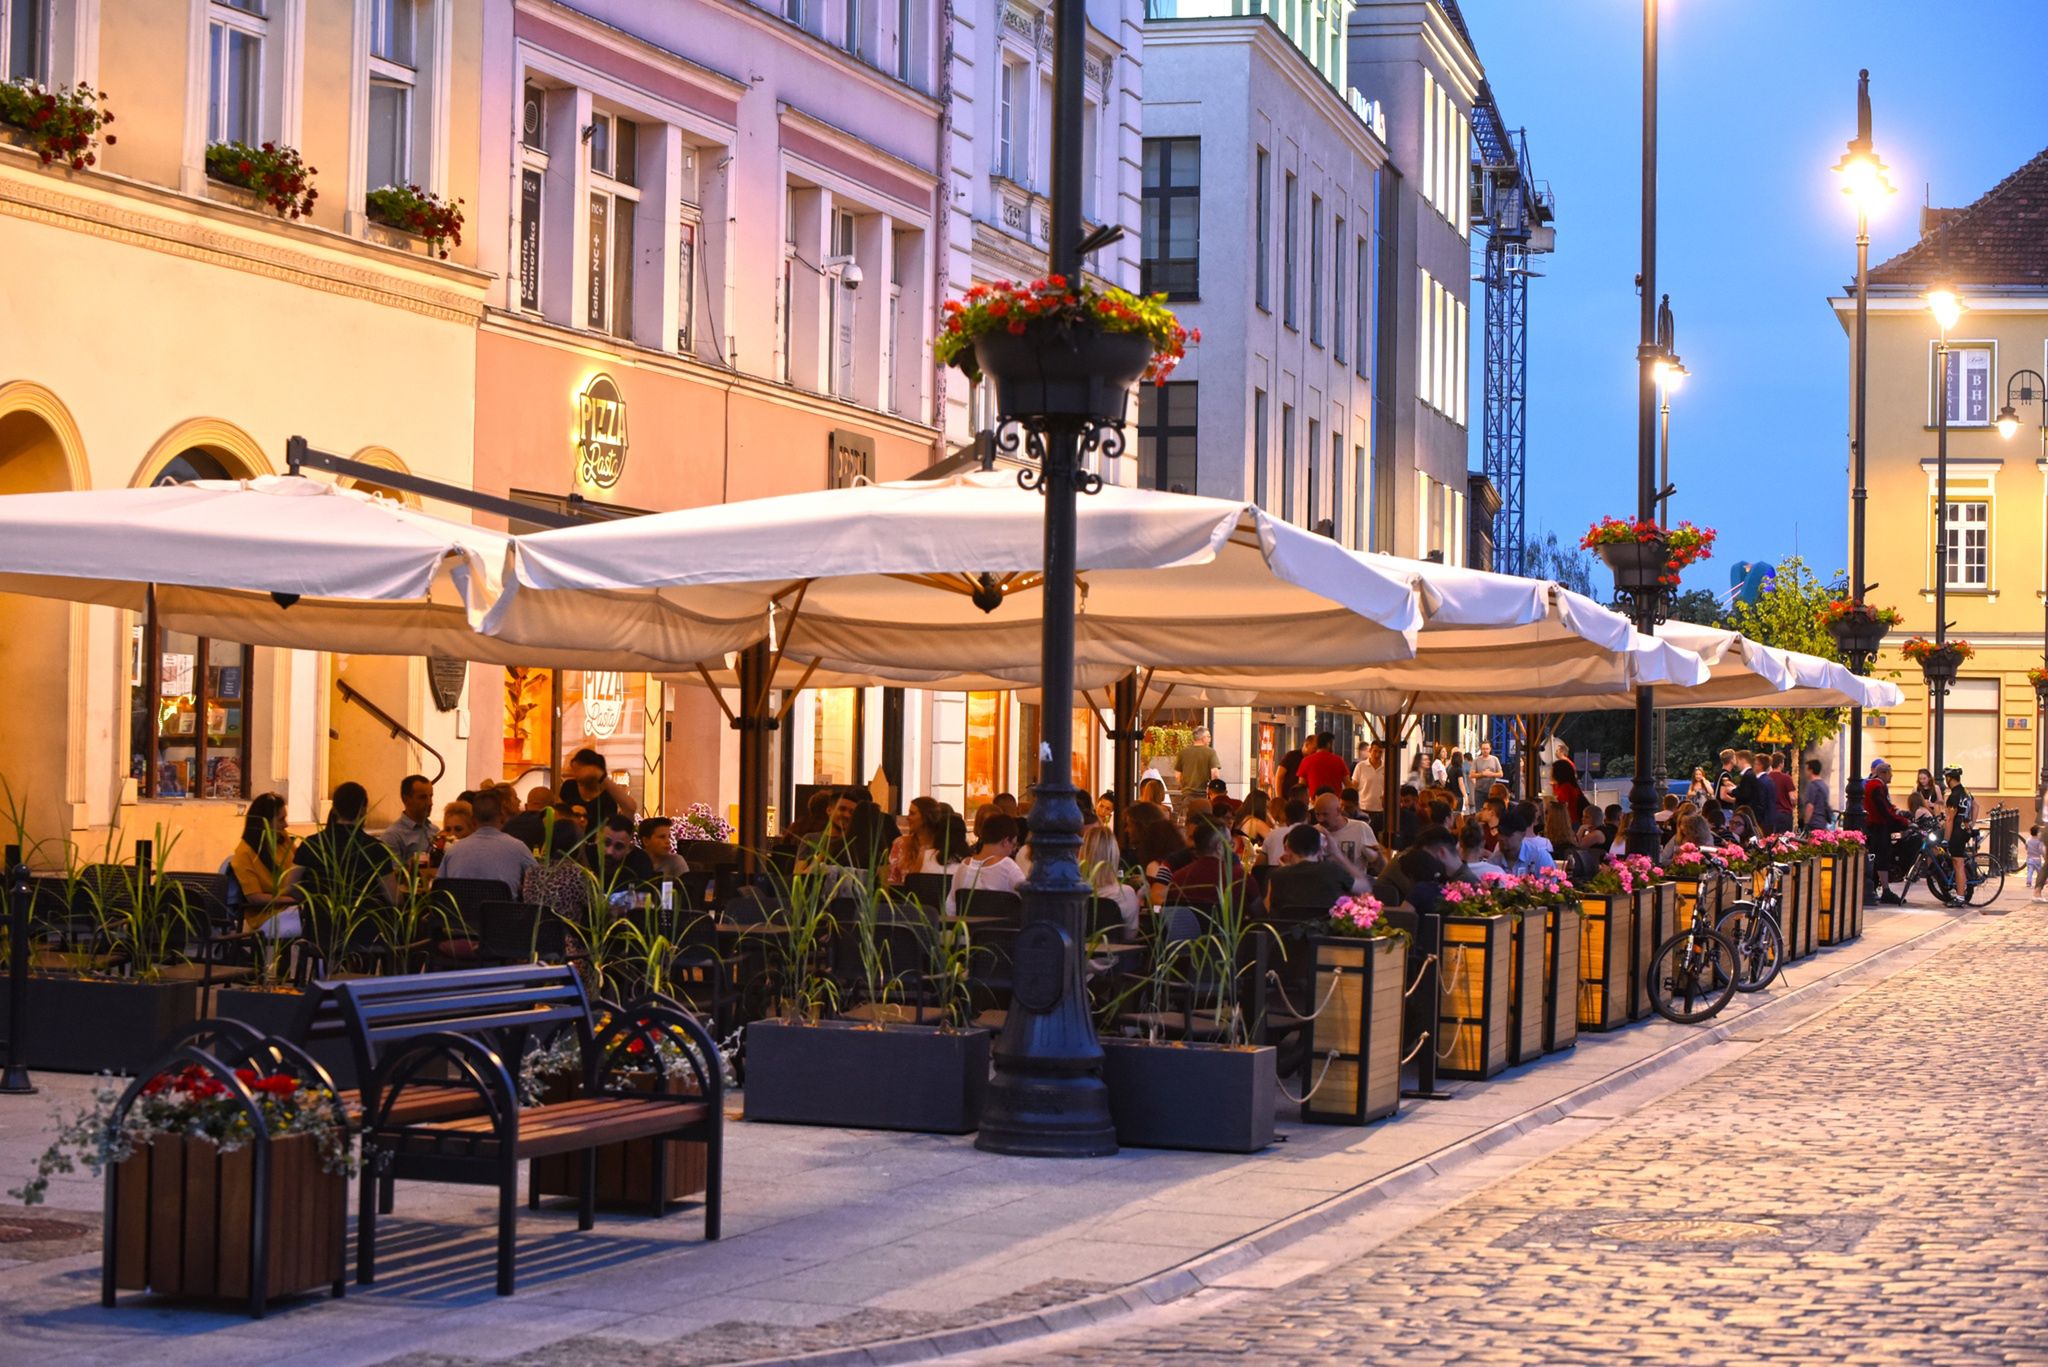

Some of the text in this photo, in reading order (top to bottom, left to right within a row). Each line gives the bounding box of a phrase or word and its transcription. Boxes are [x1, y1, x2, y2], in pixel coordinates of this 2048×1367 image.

[520, 240, 529, 299] Galeria
[527, 221, 536, 301] Pomorska
[592, 234, 600, 320] Salon NC+
[1972, 374, 1983, 416] BHP
[580, 393, 628, 448] PIZZA
[584, 443, 619, 481] Pasta
[583, 671, 624, 703] PIZZA
[585, 701, 617, 732] Pasta
